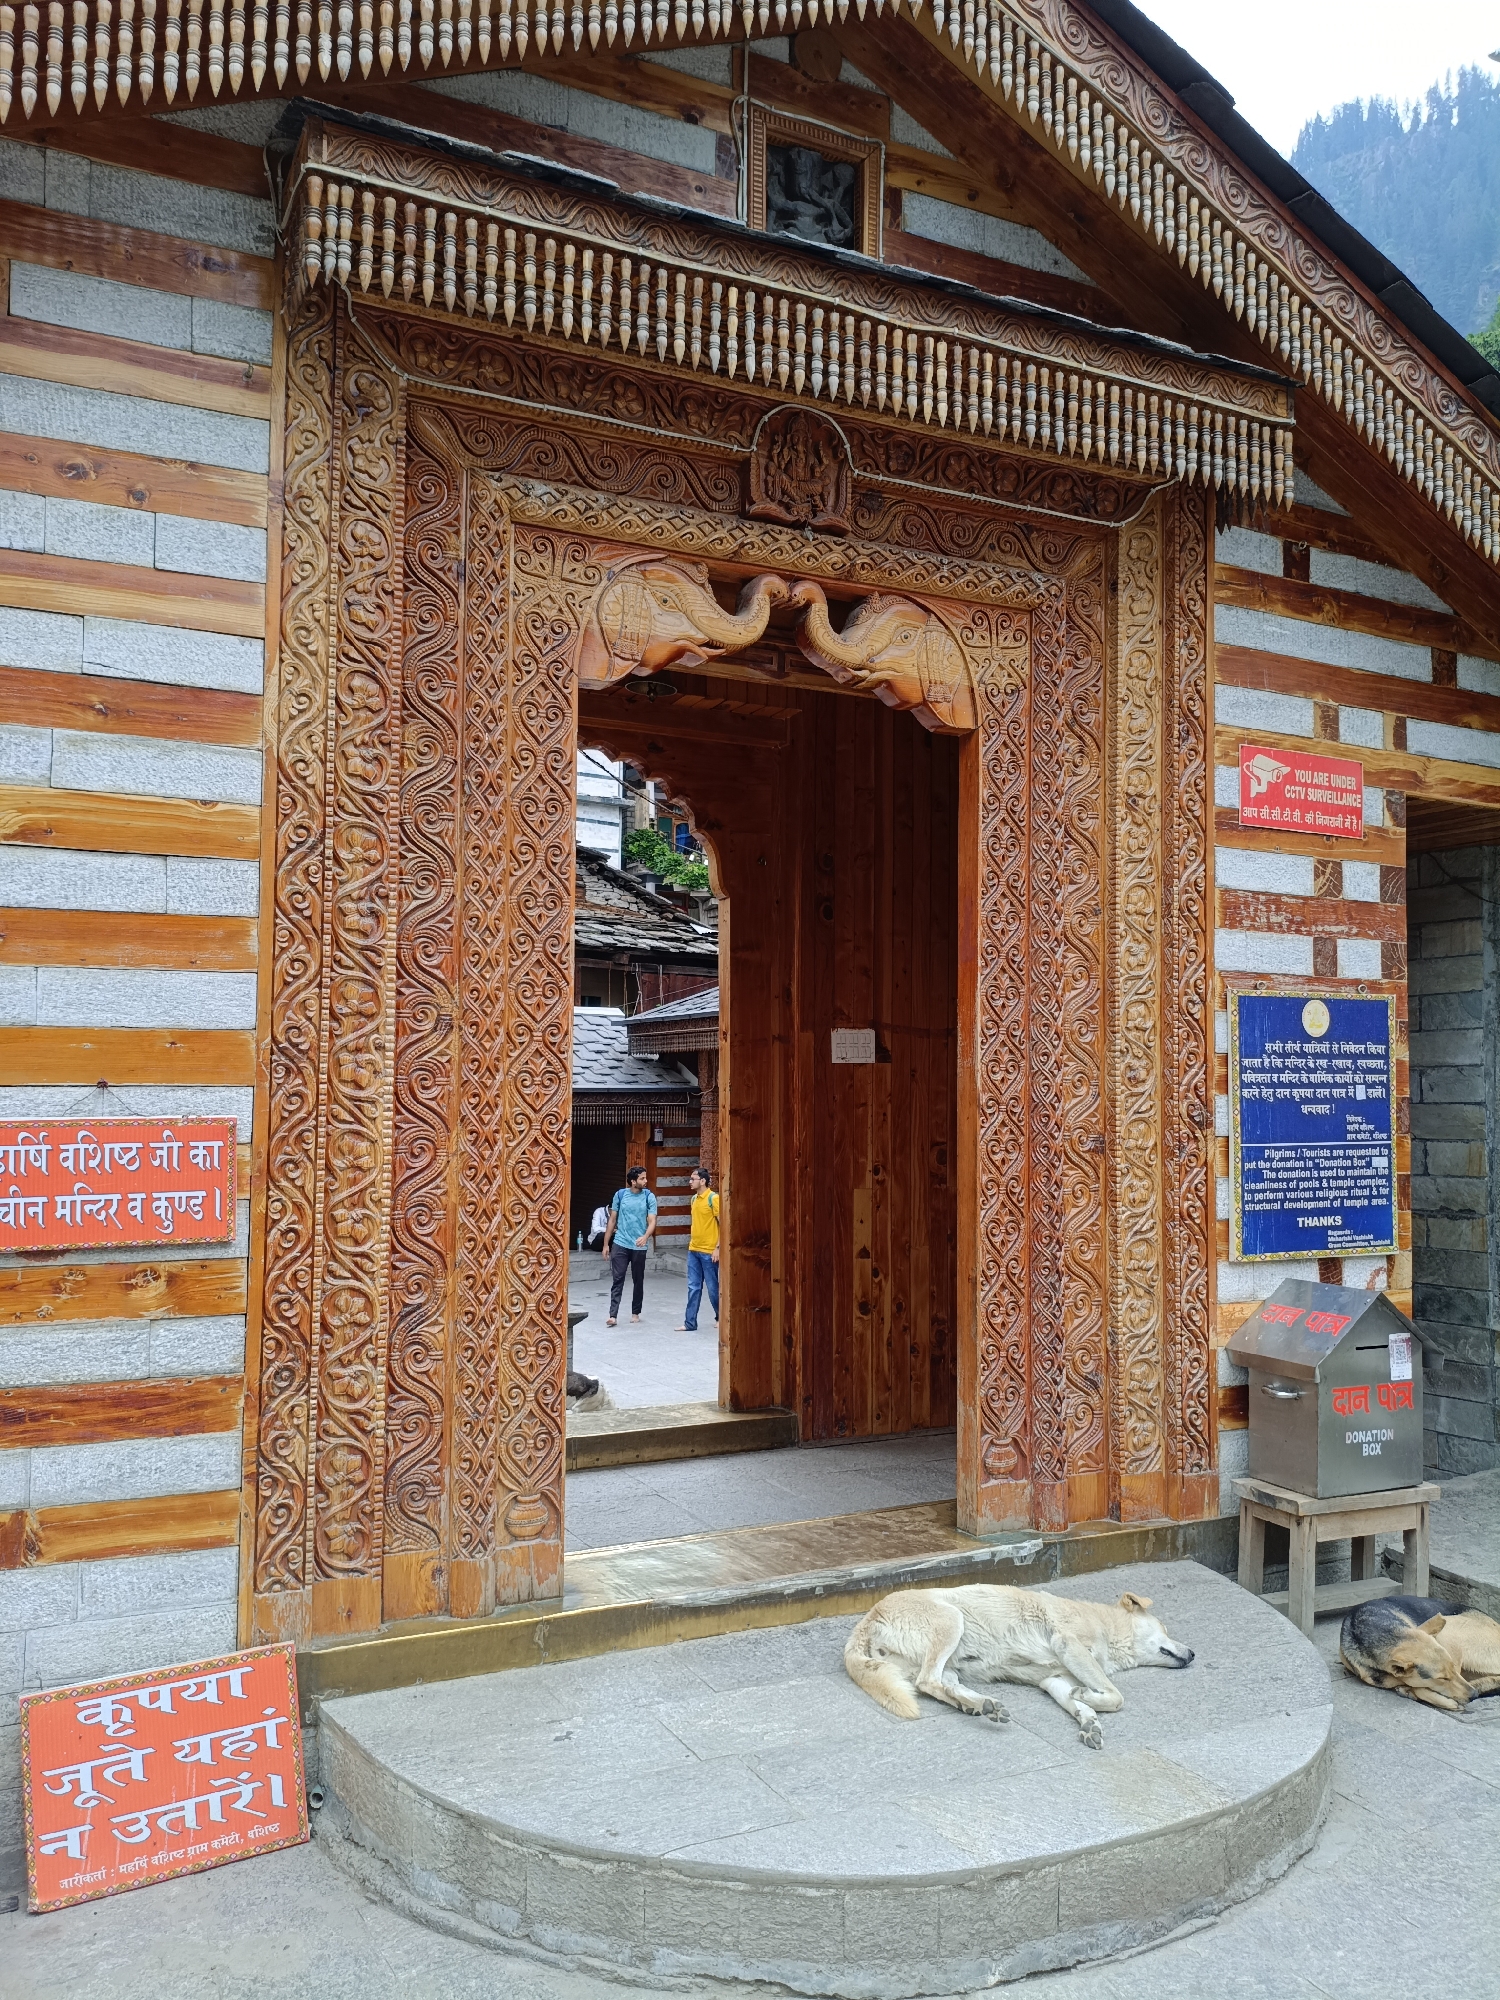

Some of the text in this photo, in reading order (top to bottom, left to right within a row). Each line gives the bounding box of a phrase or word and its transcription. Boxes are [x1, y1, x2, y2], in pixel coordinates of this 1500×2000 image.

[1294, 769, 1356, 790] YOU ARE UNDER
[1285, 785, 1361, 807] CCTV SURVEILLANCE
[1243, 807, 1257, 818] आप
[1305, 811, 1314, 824] की
[1316, 811, 1343, 828] निगरानी
[1265, 1040, 1386, 1054] सभी तीर्थ यात्रियों से निवेदन किया
[1241, 1058, 1262, 1068] जाता
[1262, 1054, 1270, 1069] है
[1271, 1055, 1284, 1068] कि
[1285, 1055, 1307, 1069] मन्दिर
[1307, 1056, 1315, 1068] के
[1242, 1070, 1271, 1083] पवित्रता
[1272, 1074, 1279, 1083] व
[1279, 1070, 1300, 1084] मन्दिर
[1300, 1071, 1309, 1083] के
[1334, 1071, 1353, 1083] कार्यों
[1354, 1071, 1364, 1083] को
[1242, 1085, 1260, 1100] करने
[1260, 1085, 1274, 1102] हेतु
[1275, 1089, 1291, 1098] दान
[1292, 1089, 1314, 1101] कृपया
[1316, 1089, 1330, 1098] दान
[1332, 1089, 1346, 1098] पात्र
[1301, 1104, 1330, 1115] धन्यवाद
[59, 1130, 143, 1175] वशिष्ठ
[149, 1129, 183, 1172] जी
[189, 1140, 224, 1171] का
[1264, 1149, 1296, 1160] Pilgrims
[1301, 1148, 1330, 1157] Tourists
[1346, 1147, 1379, 1158] requested
[1381, 1147, 1388, 1156] to
[1244, 1160, 1256, 1171] put
[1258, 1160, 1270, 1168] the
[1272, 1159, 1304, 1168] donation
[1306, 1159, 1313, 1167] in
[1262, 1167, 1388, 1179] The donation is used to maintain the
[1244, 1177, 1388, 1189] cleanliness of pools & temple complex,
[1244, 1187, 1389, 1202] to perform various religious ritual & for
[55, 1182, 123, 1230] मन्दिर
[128, 1192, 146, 1224] व
[152, 1190, 207, 1234] कुण्ड
[1244, 1197, 1389, 1210] structural development of temple area.
[1297, 1215, 1342, 1228] THANKS
[1261, 1303, 1352, 1336] दान पात्र
[1331, 1381, 1414, 1417] दान पात्र
[1345, 1429, 1394, 1444] DONATION
[1362, 1442, 1382, 1456] BOX
[74, 1666, 254, 1737] कृपया
[40, 1706, 289, 1808] जूते यहां
[37, 1823, 95, 1859] न
[59, 1867, 107, 1889] जारीकर्ता
[119, 1855, 148, 1874] महर्षि
[187, 1841, 208, 1857] ग्राम
